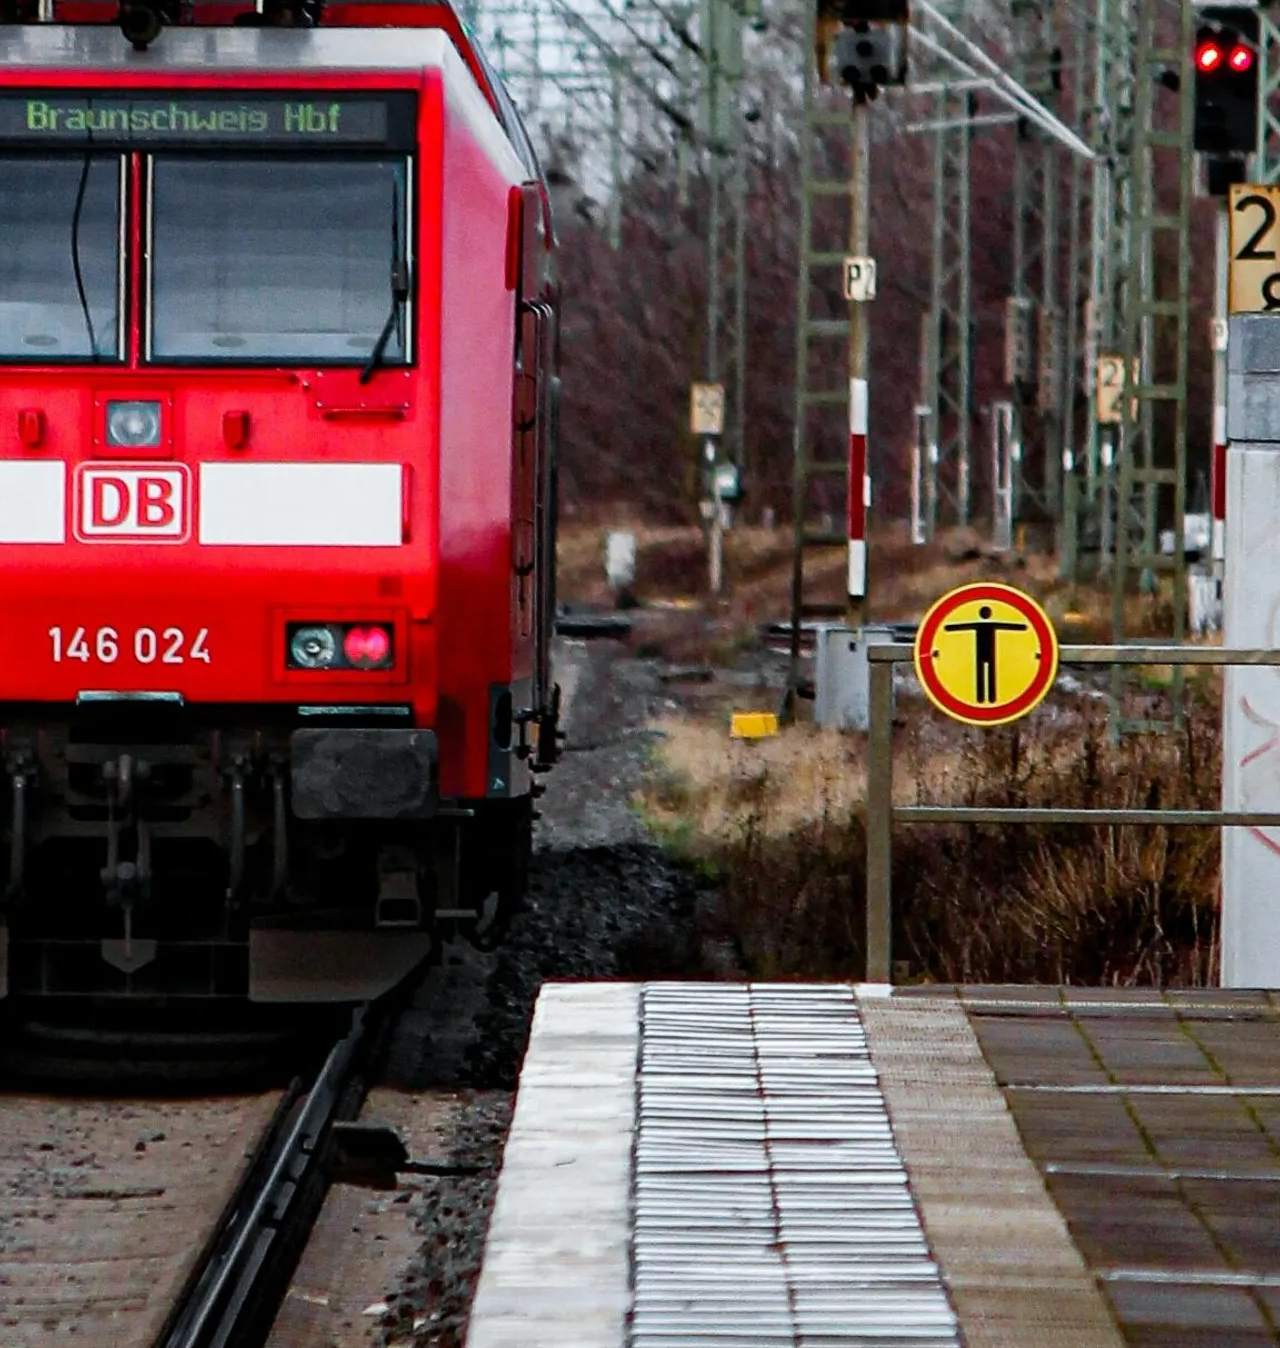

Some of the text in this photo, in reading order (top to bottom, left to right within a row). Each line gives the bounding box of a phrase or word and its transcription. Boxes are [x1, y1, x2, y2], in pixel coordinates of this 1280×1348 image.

[27, 100, 267, 132] Braunschweig
[284, 102, 341, 133] Hbf
[91, 476, 176, 528] DB
[47, 625, 212, 665] 146 024
